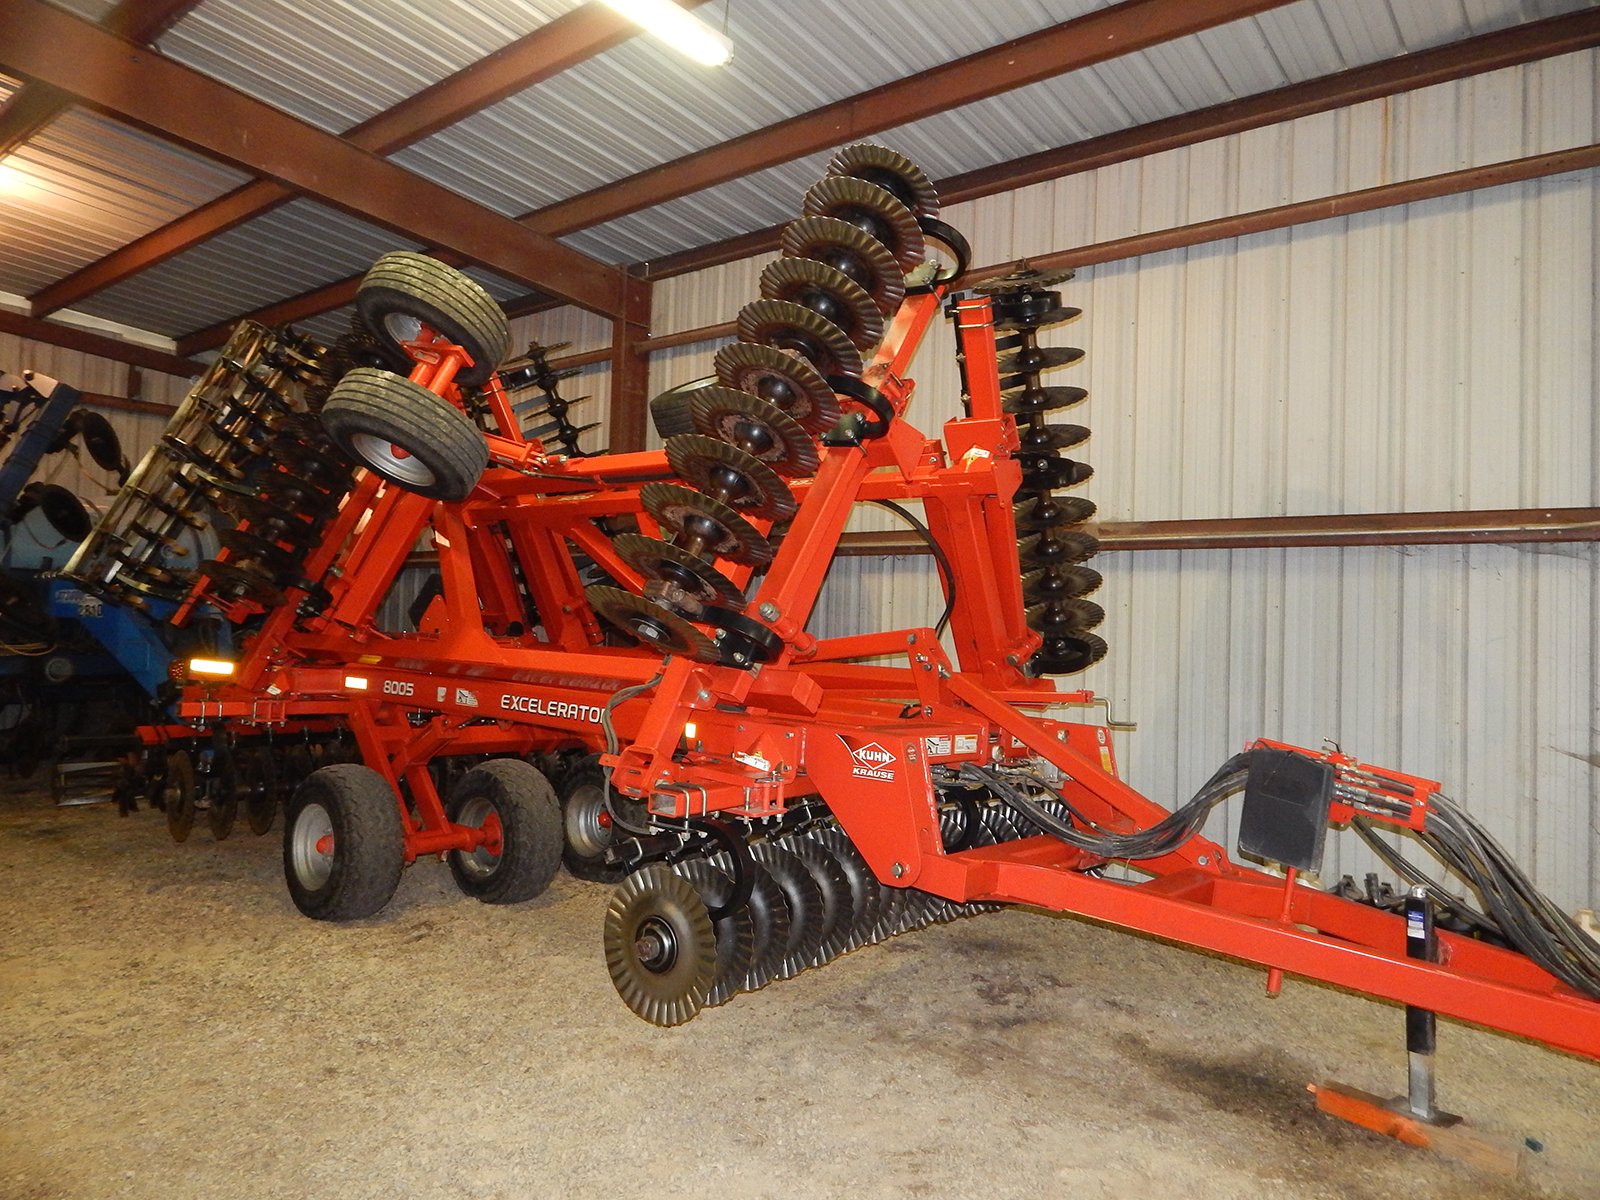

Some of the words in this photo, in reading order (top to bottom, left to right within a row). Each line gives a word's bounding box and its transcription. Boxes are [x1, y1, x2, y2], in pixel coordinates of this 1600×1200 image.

[383, 680, 414, 696] 8005
[859, 750, 890, 762] KUHN
[853, 767, 895, 780] KRAUSE
